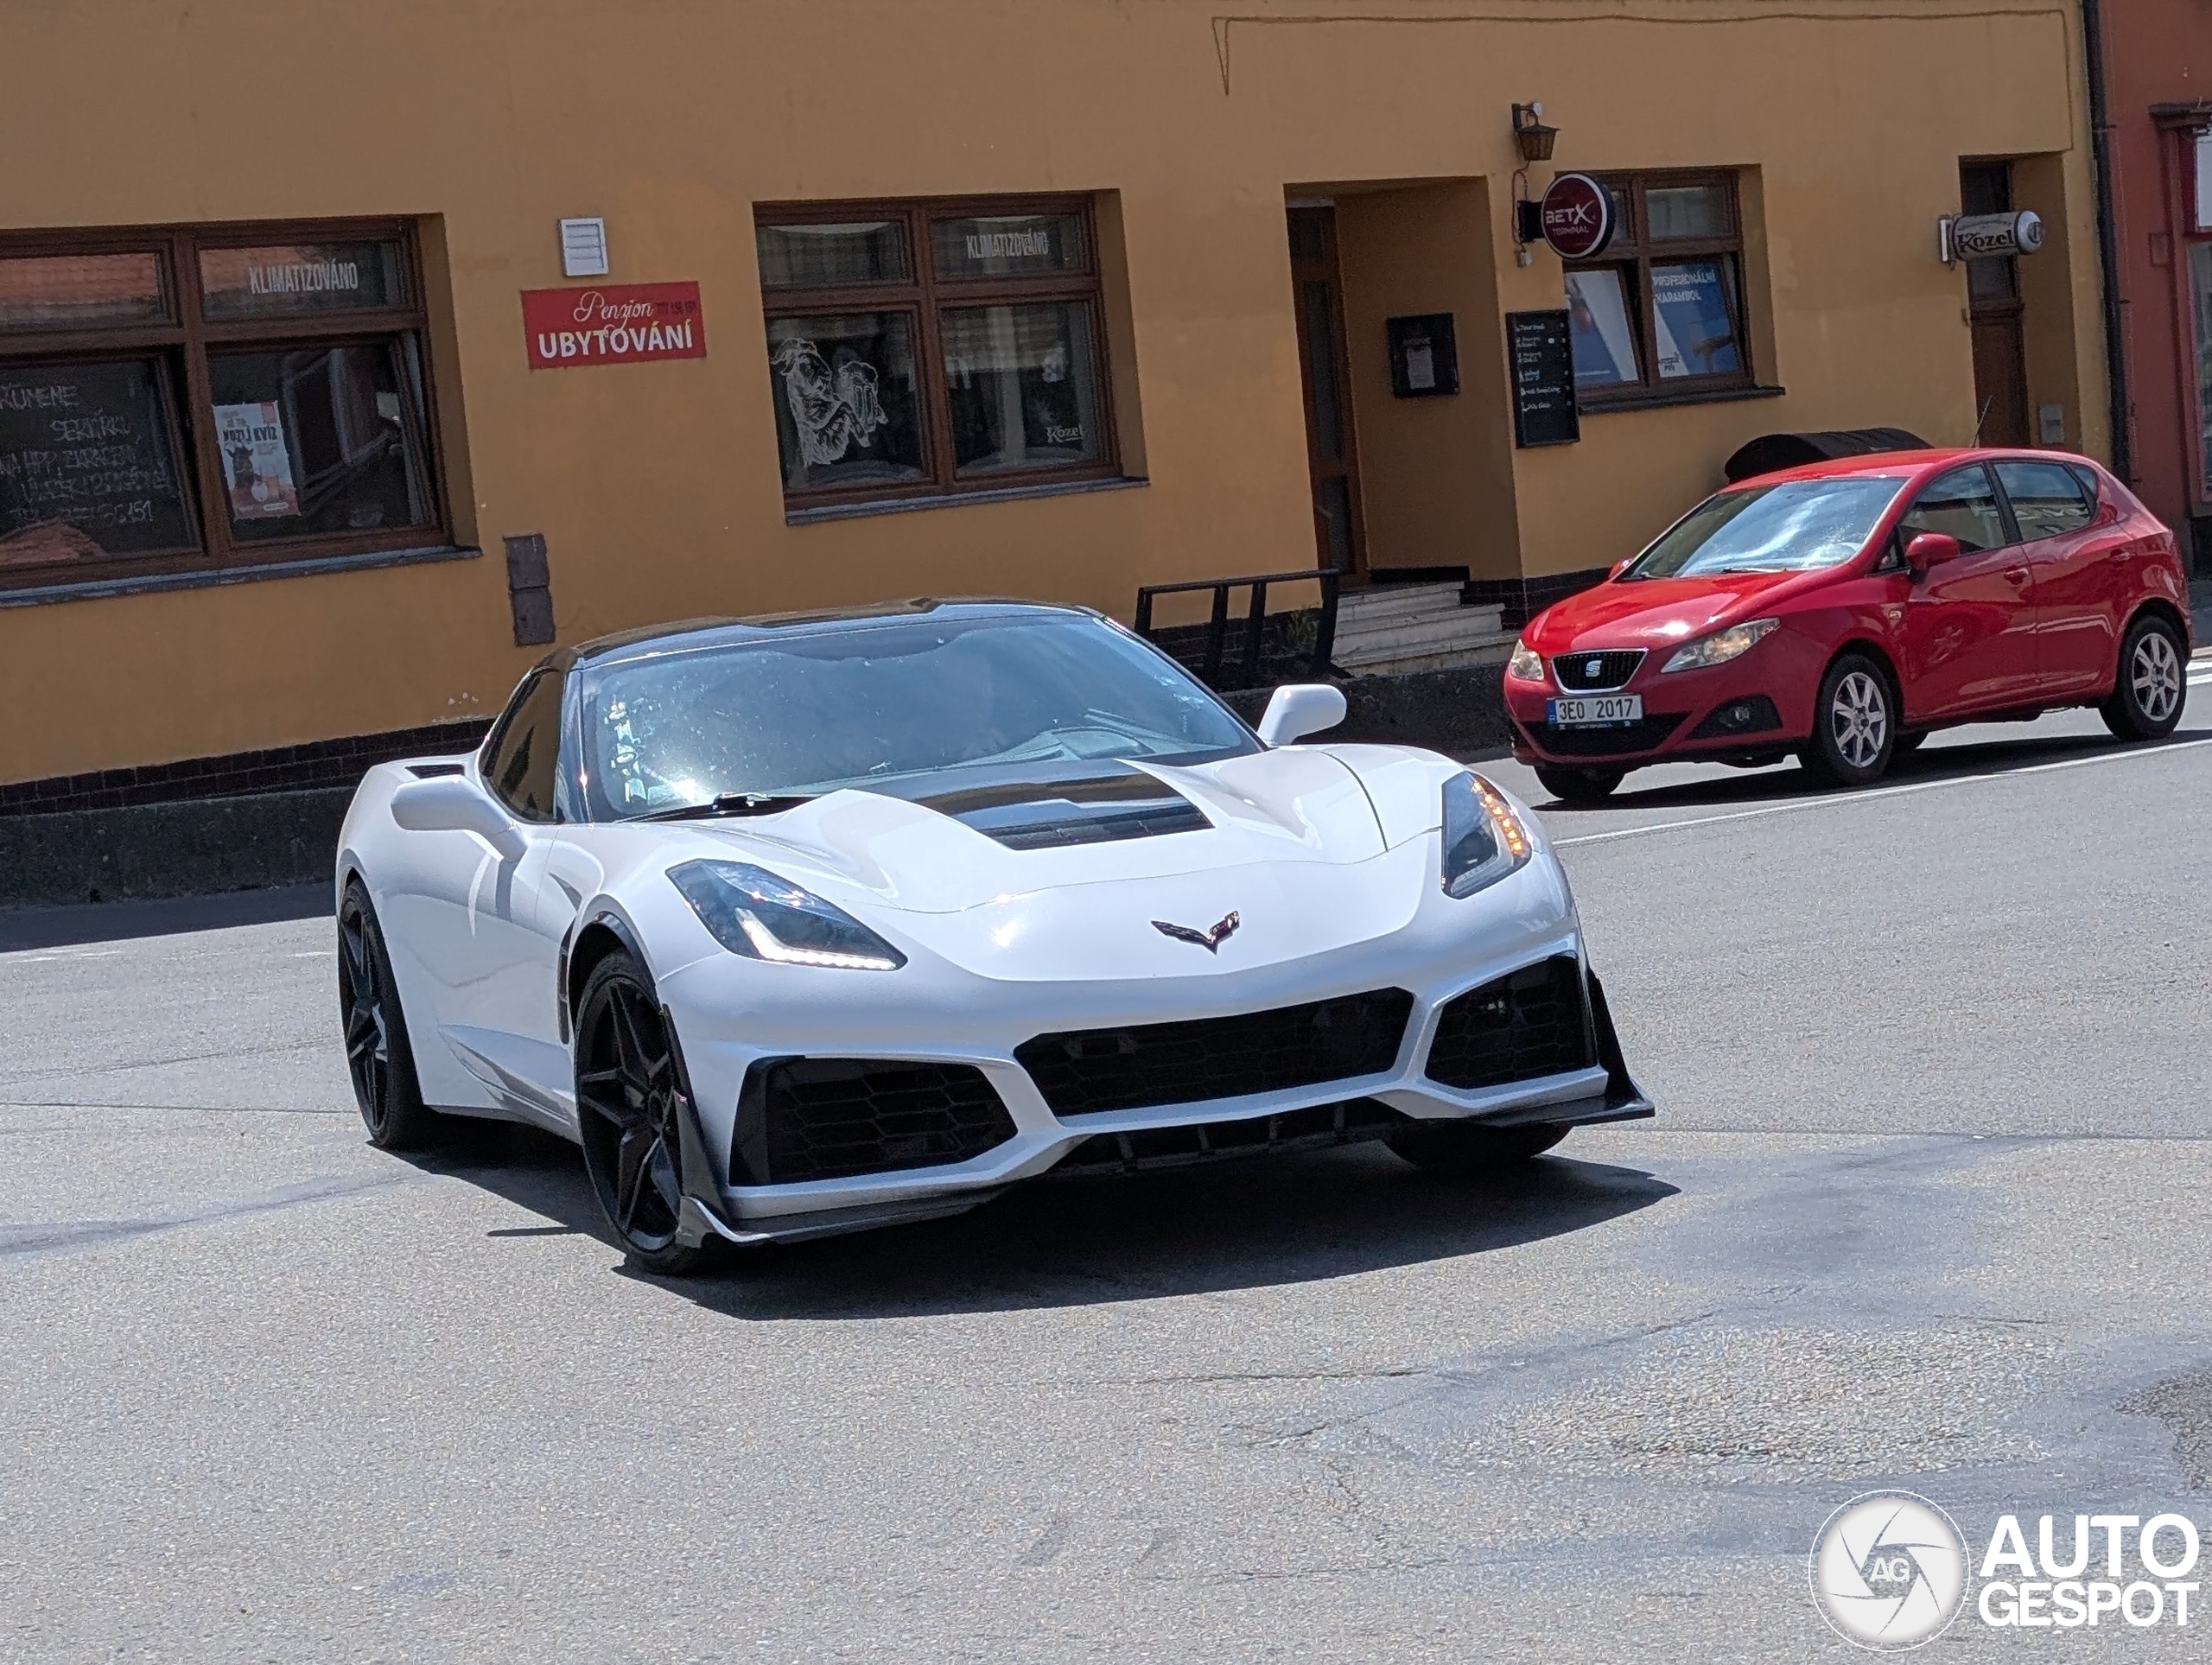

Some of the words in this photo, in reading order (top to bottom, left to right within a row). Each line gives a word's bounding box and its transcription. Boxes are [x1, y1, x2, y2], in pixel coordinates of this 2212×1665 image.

[966, 227, 1049, 258] KLIMATIZOVÁNO
[1956, 229, 2018, 253] Kozel
[249, 257, 359, 295] KLIMATIZOVÁNO
[574, 291, 654, 332] Penzion
[538, 319, 693, 359] UBYTOVÁNÍ
[1045, 423, 1085, 443] Kozel
[1596, 698, 1633, 719] 2017
